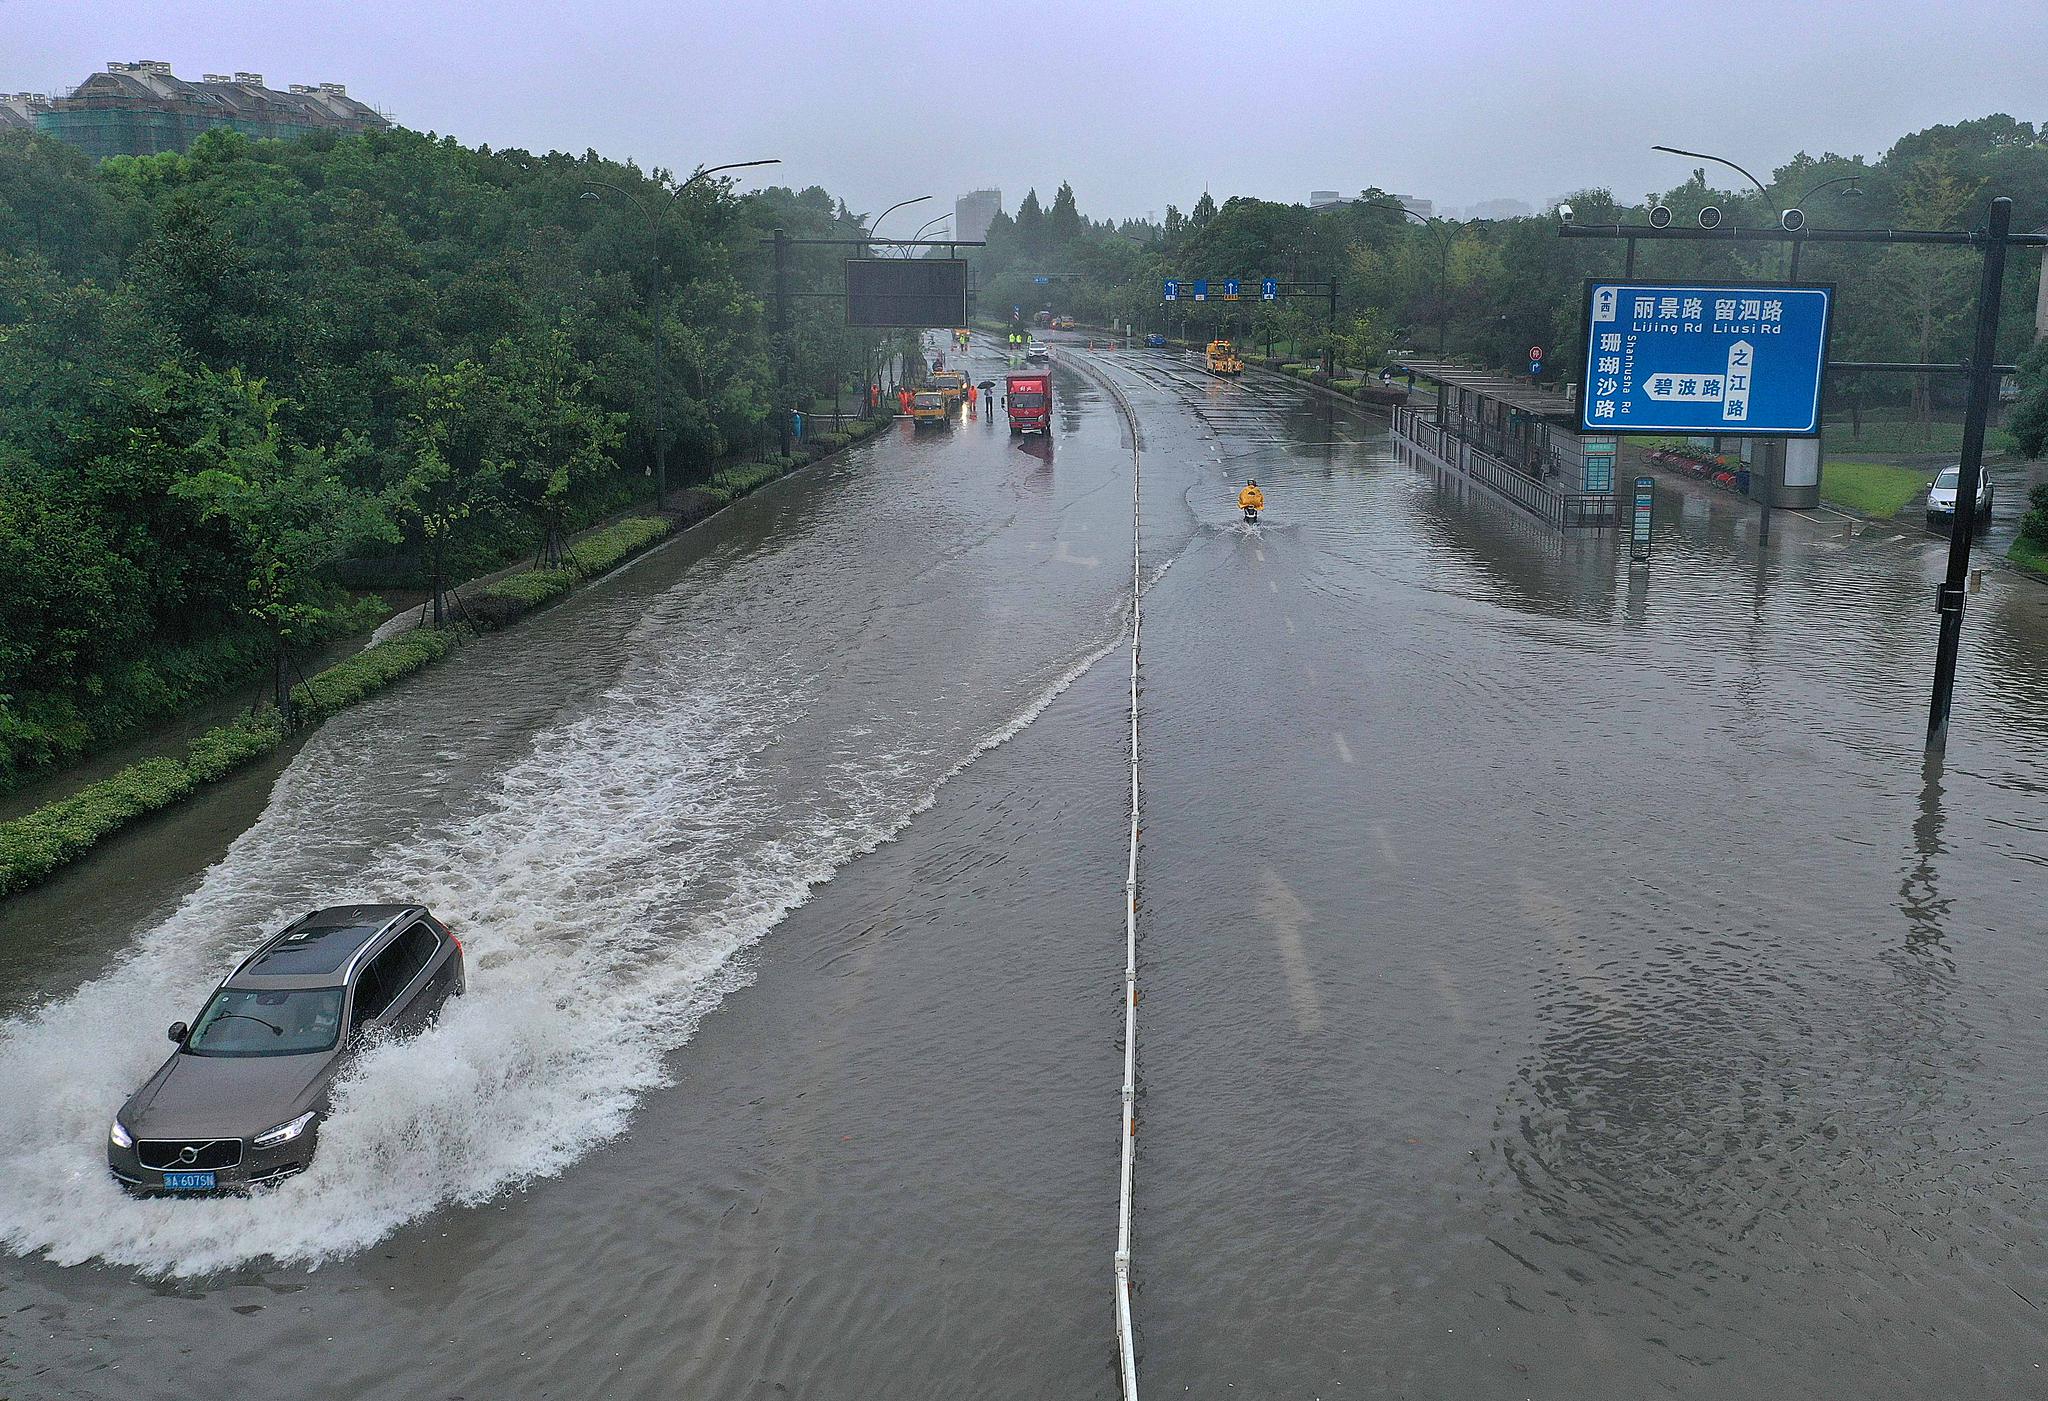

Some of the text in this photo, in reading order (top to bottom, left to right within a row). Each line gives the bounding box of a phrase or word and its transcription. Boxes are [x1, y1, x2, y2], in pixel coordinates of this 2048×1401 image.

[1600, 302, 1611, 313] 西
[1633, 297, 1783, 322] 丽景路 留泗路
[1633, 322, 1781, 335] Lijing Rd Liusi Rd
[1594, 333, 1622, 418] 珊瑚沙路
[1621, 335, 1637, 414] Shanhusha Rd
[1726, 350, 1749, 417] 之江路
[1653, 379, 1721, 397] 碧波路
